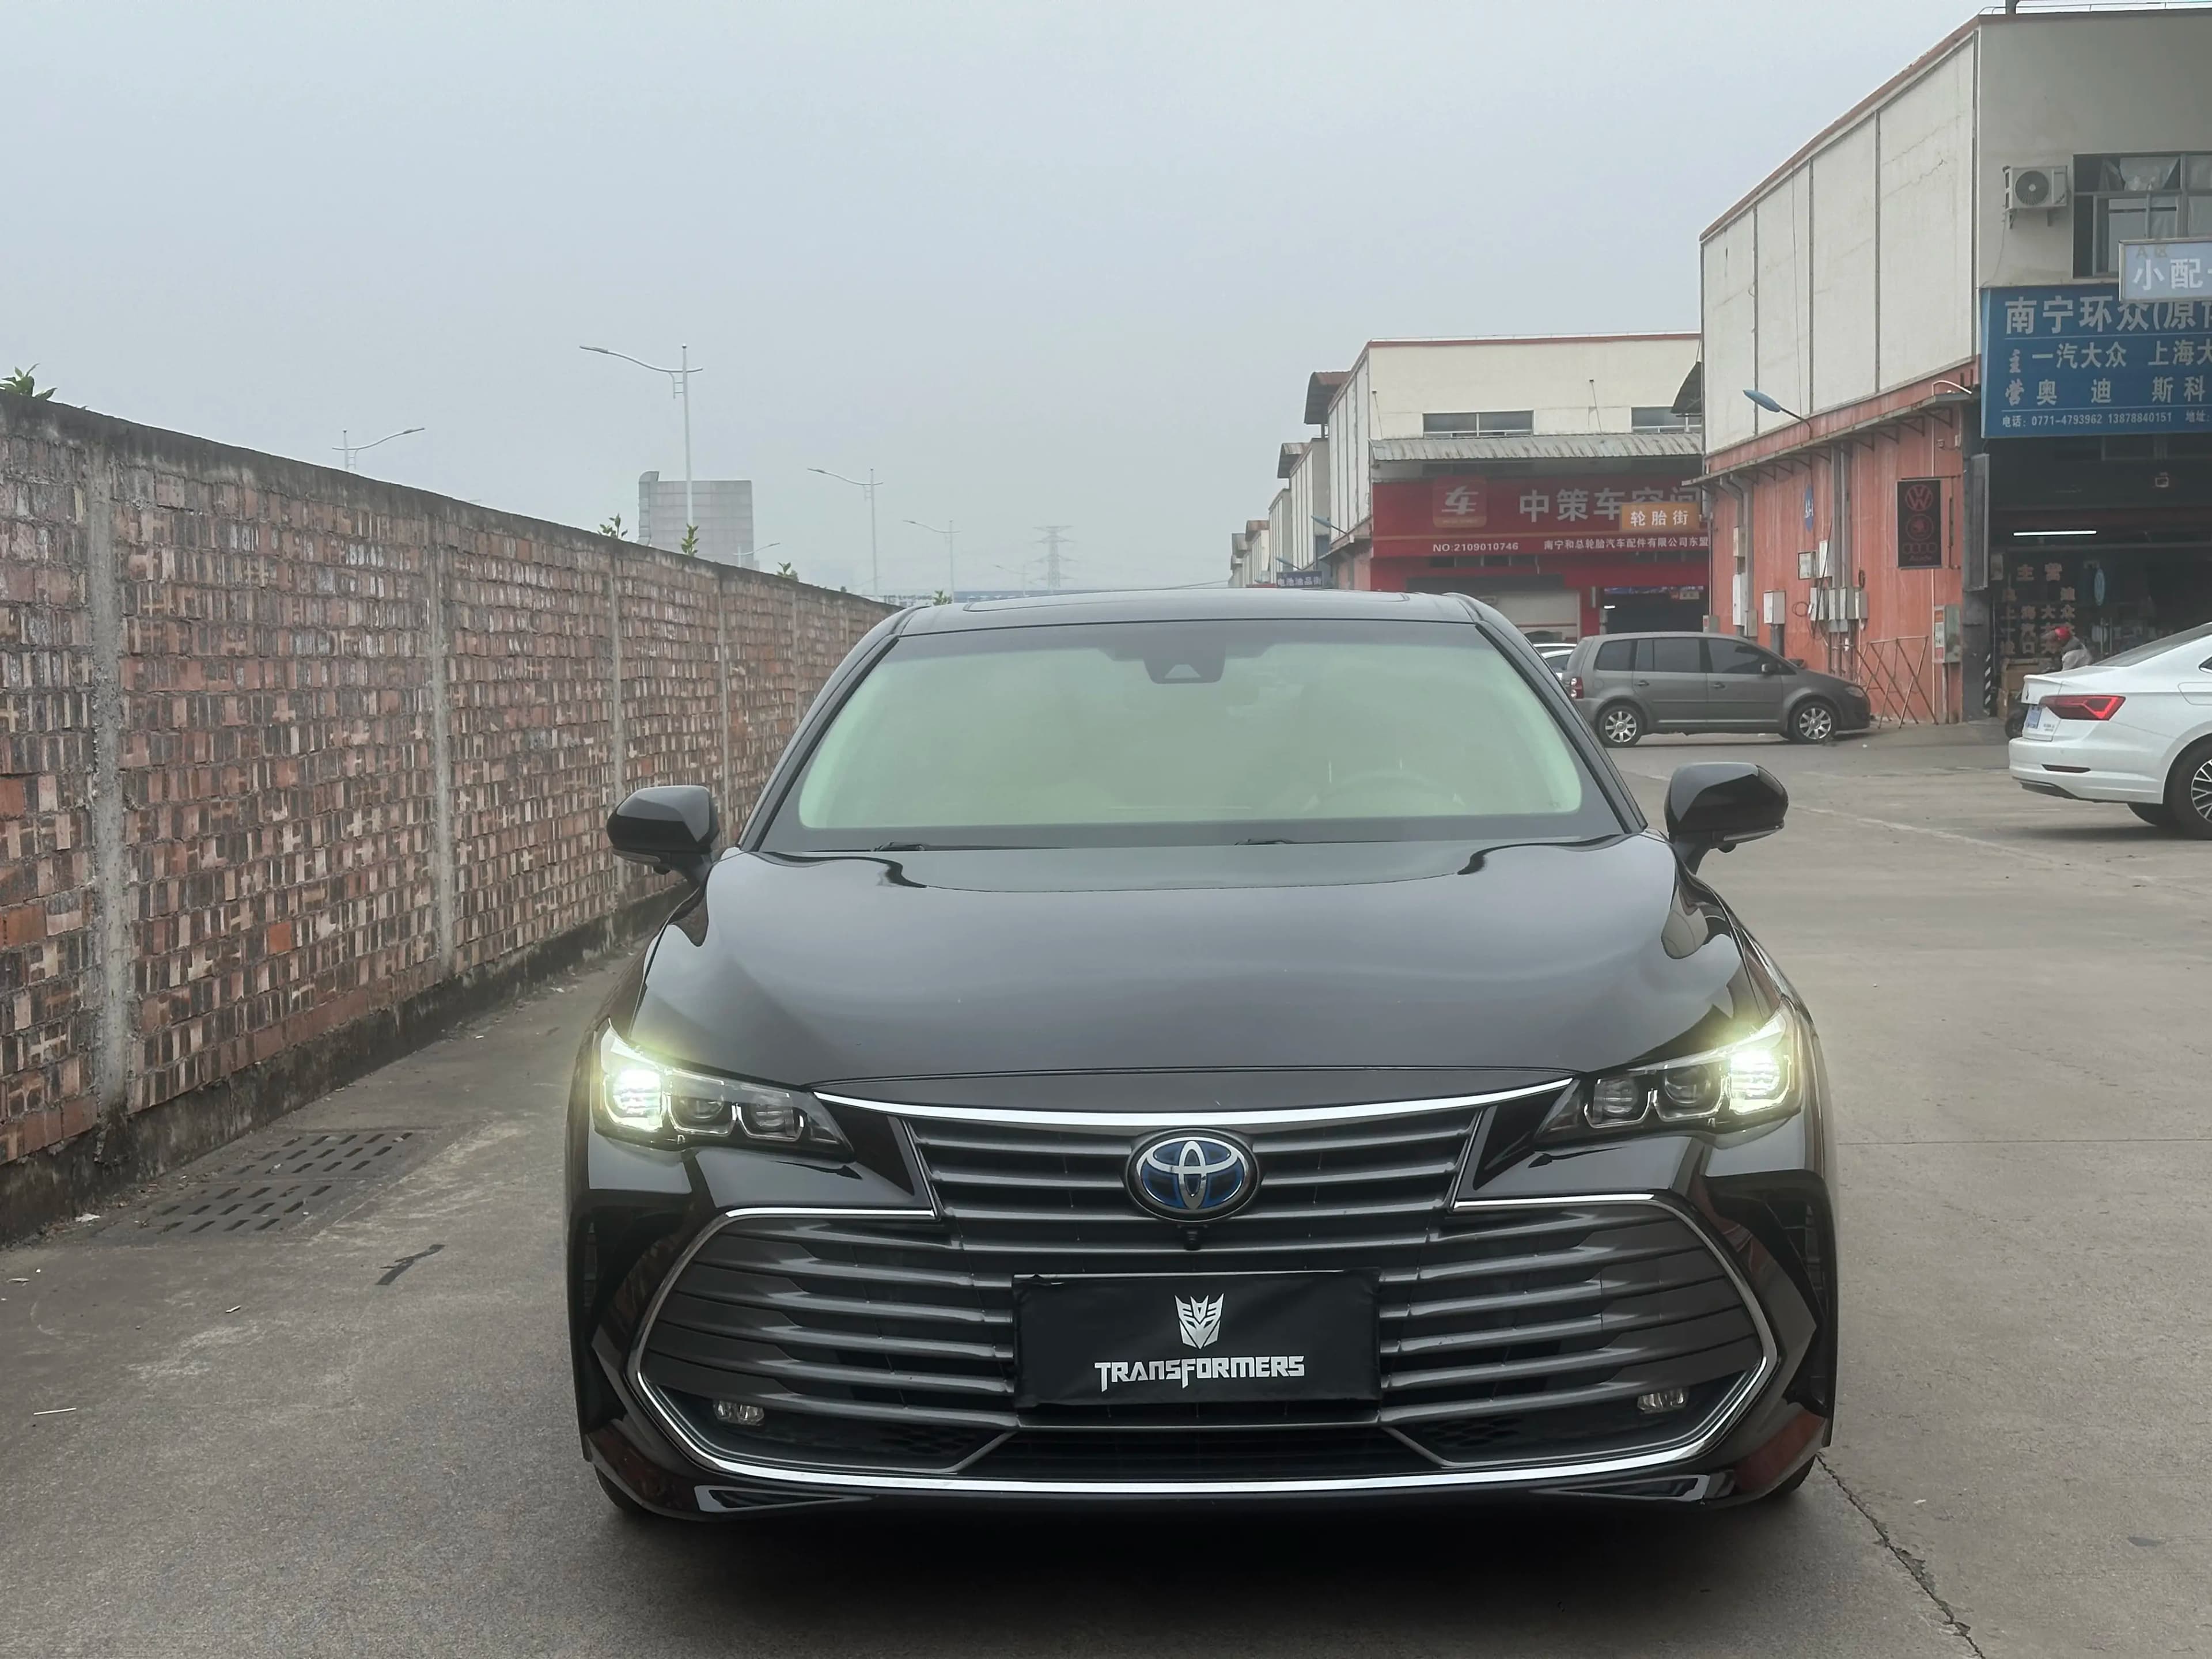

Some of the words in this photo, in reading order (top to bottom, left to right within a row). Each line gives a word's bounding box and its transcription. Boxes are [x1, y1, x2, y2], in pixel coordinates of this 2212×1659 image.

[2133, 257, 2212, 291] 小配
[2032, 341, 2127, 369] 一汽大众
[2031, 414, 2103, 426] 0771-4793962
[2108, 411, 2172, 424] 13878840151
[1630, 509, 1689, 527] 轮胎街
[1094, 1355, 1305, 1392] TRANSFORMERS
